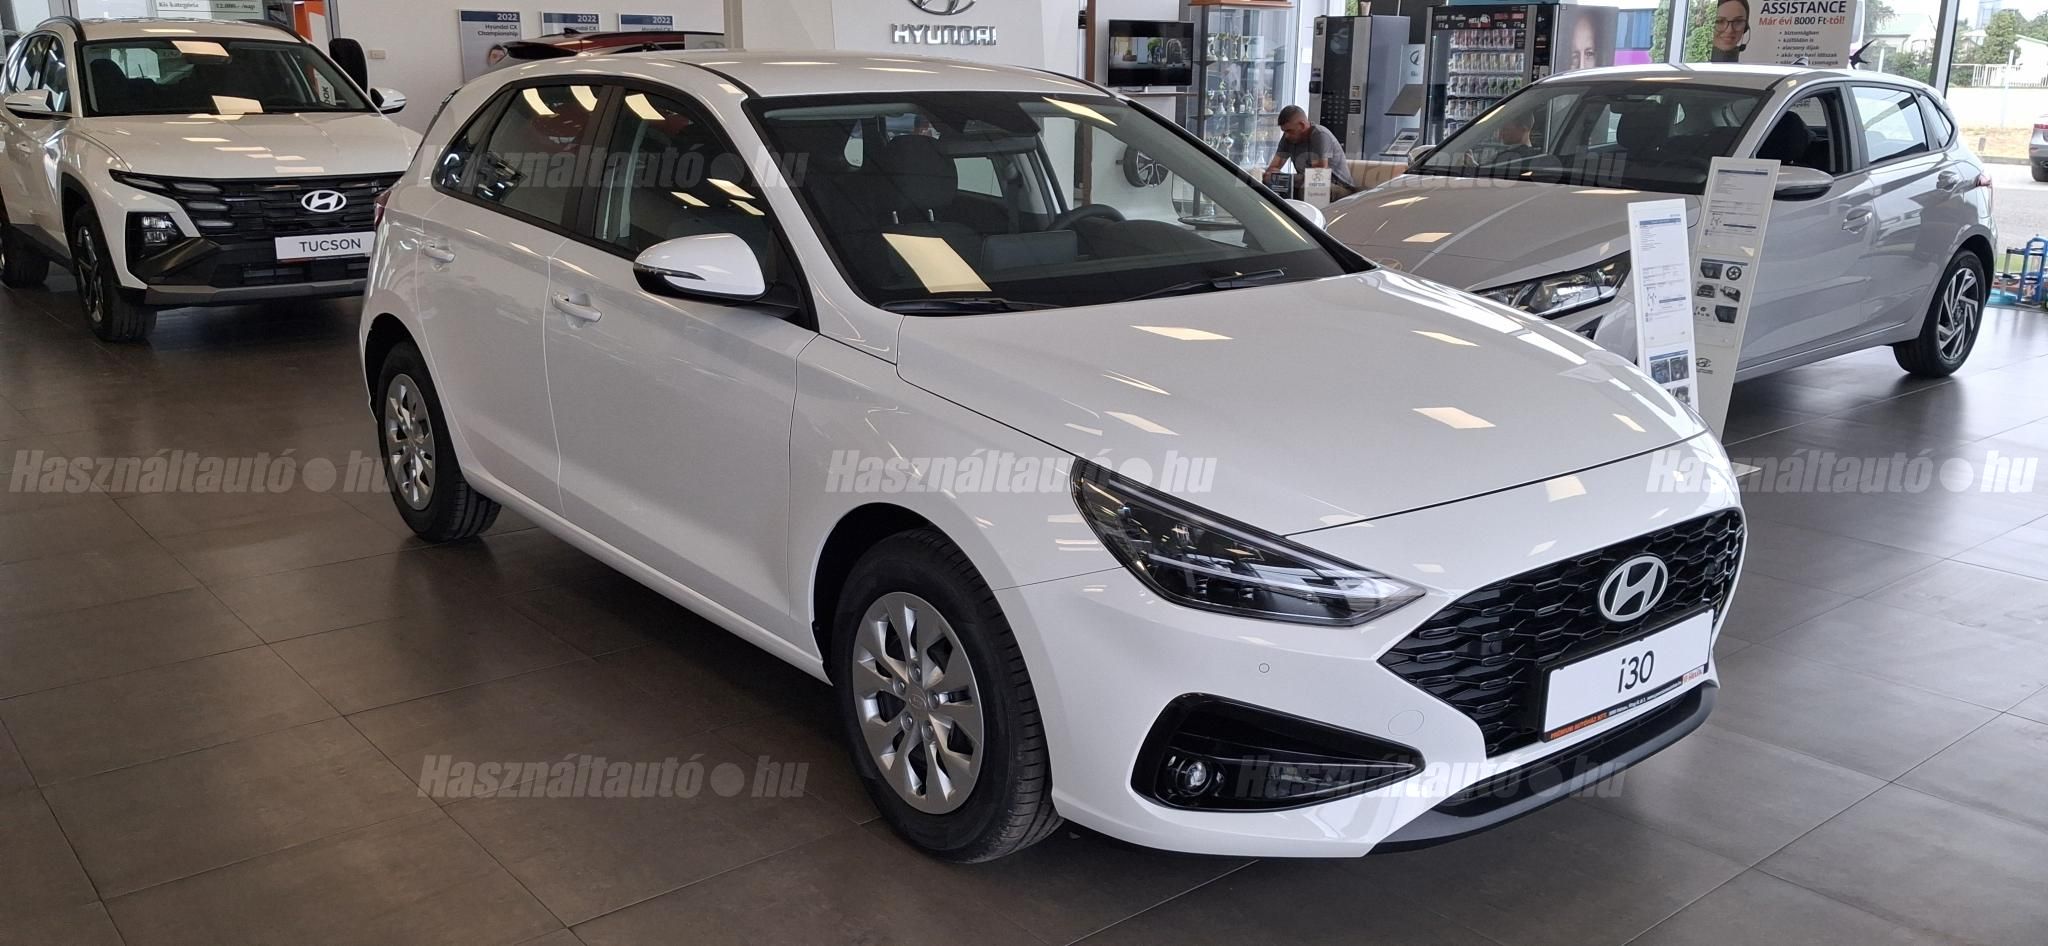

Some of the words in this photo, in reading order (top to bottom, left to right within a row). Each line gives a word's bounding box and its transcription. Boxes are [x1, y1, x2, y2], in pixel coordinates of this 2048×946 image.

[1760, 1, 1847, 14] ASSISTANCE
[497, 13, 518, 21] 2022
[652, 16, 671, 24] 2022
[1759, 16, 1778, 25] Már
[1779, 16, 1792, 25] évi
[1794, 16, 1816, 25] 8000
[1817, 16, 1845, 25] Ft-tól!
[890, 23, 997, 46] HYUNDAI
[299, 238, 361, 252] TUCSON
[1617, 650, 1655, 693] i30
